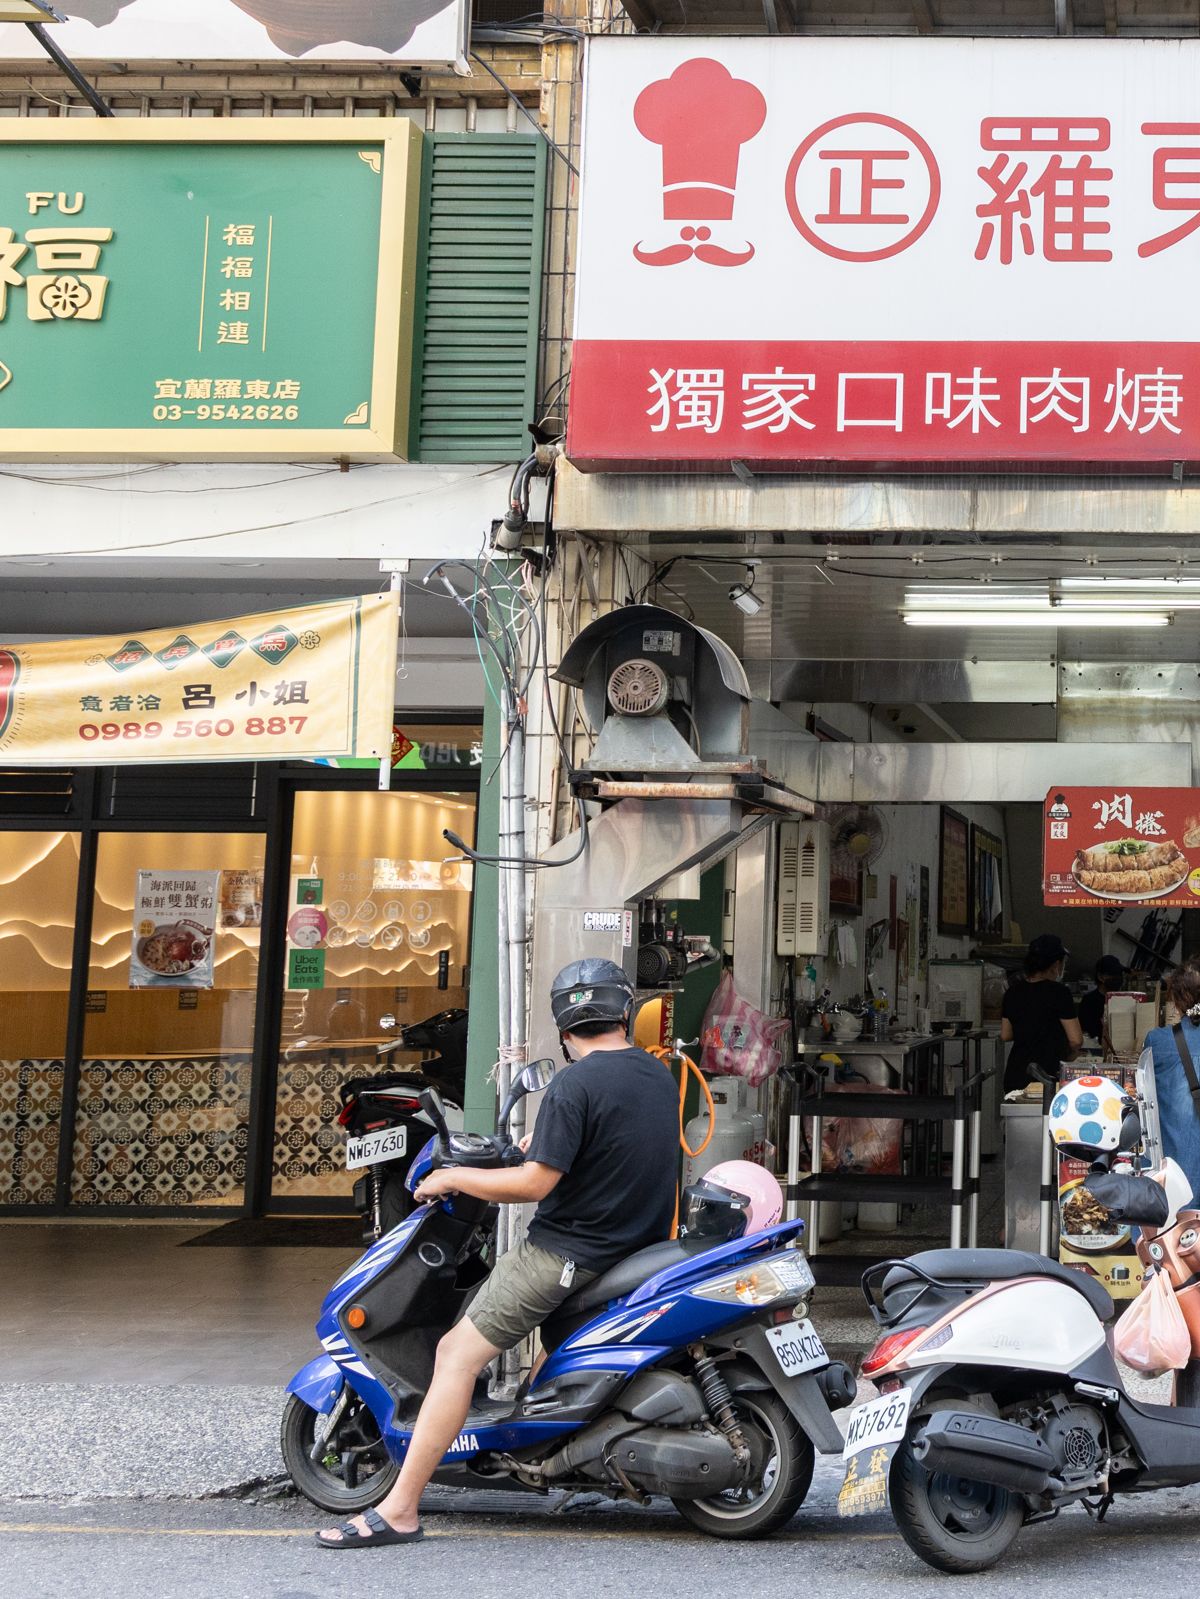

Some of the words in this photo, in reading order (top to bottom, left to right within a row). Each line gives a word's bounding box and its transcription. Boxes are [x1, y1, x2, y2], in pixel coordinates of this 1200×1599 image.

[26, 192, 84, 215] FU
[216, 224, 256, 345] 福福相連
[154, 379, 300, 400] 宜蘭羅東店
[153, 405, 299, 421] 03-9542626
[79, 694, 162, 712] 意者洽
[182, 683, 216, 710] 呂
[235, 680, 310, 707] 小姐
[79, 721, 163, 741] 0989
[173, 719, 235, 738] 560
[245, 716, 309, 736] 887
[1100, 793, 1163, 836] 肉捲
[151, 880, 196, 891] 海派回歸
[141, 893, 213, 909] 極鮮雙蟹粥
[584, 912, 621, 925] CRUDE
[295, 955, 318, 964] Uber
[295, 965, 318, 974] Eats
